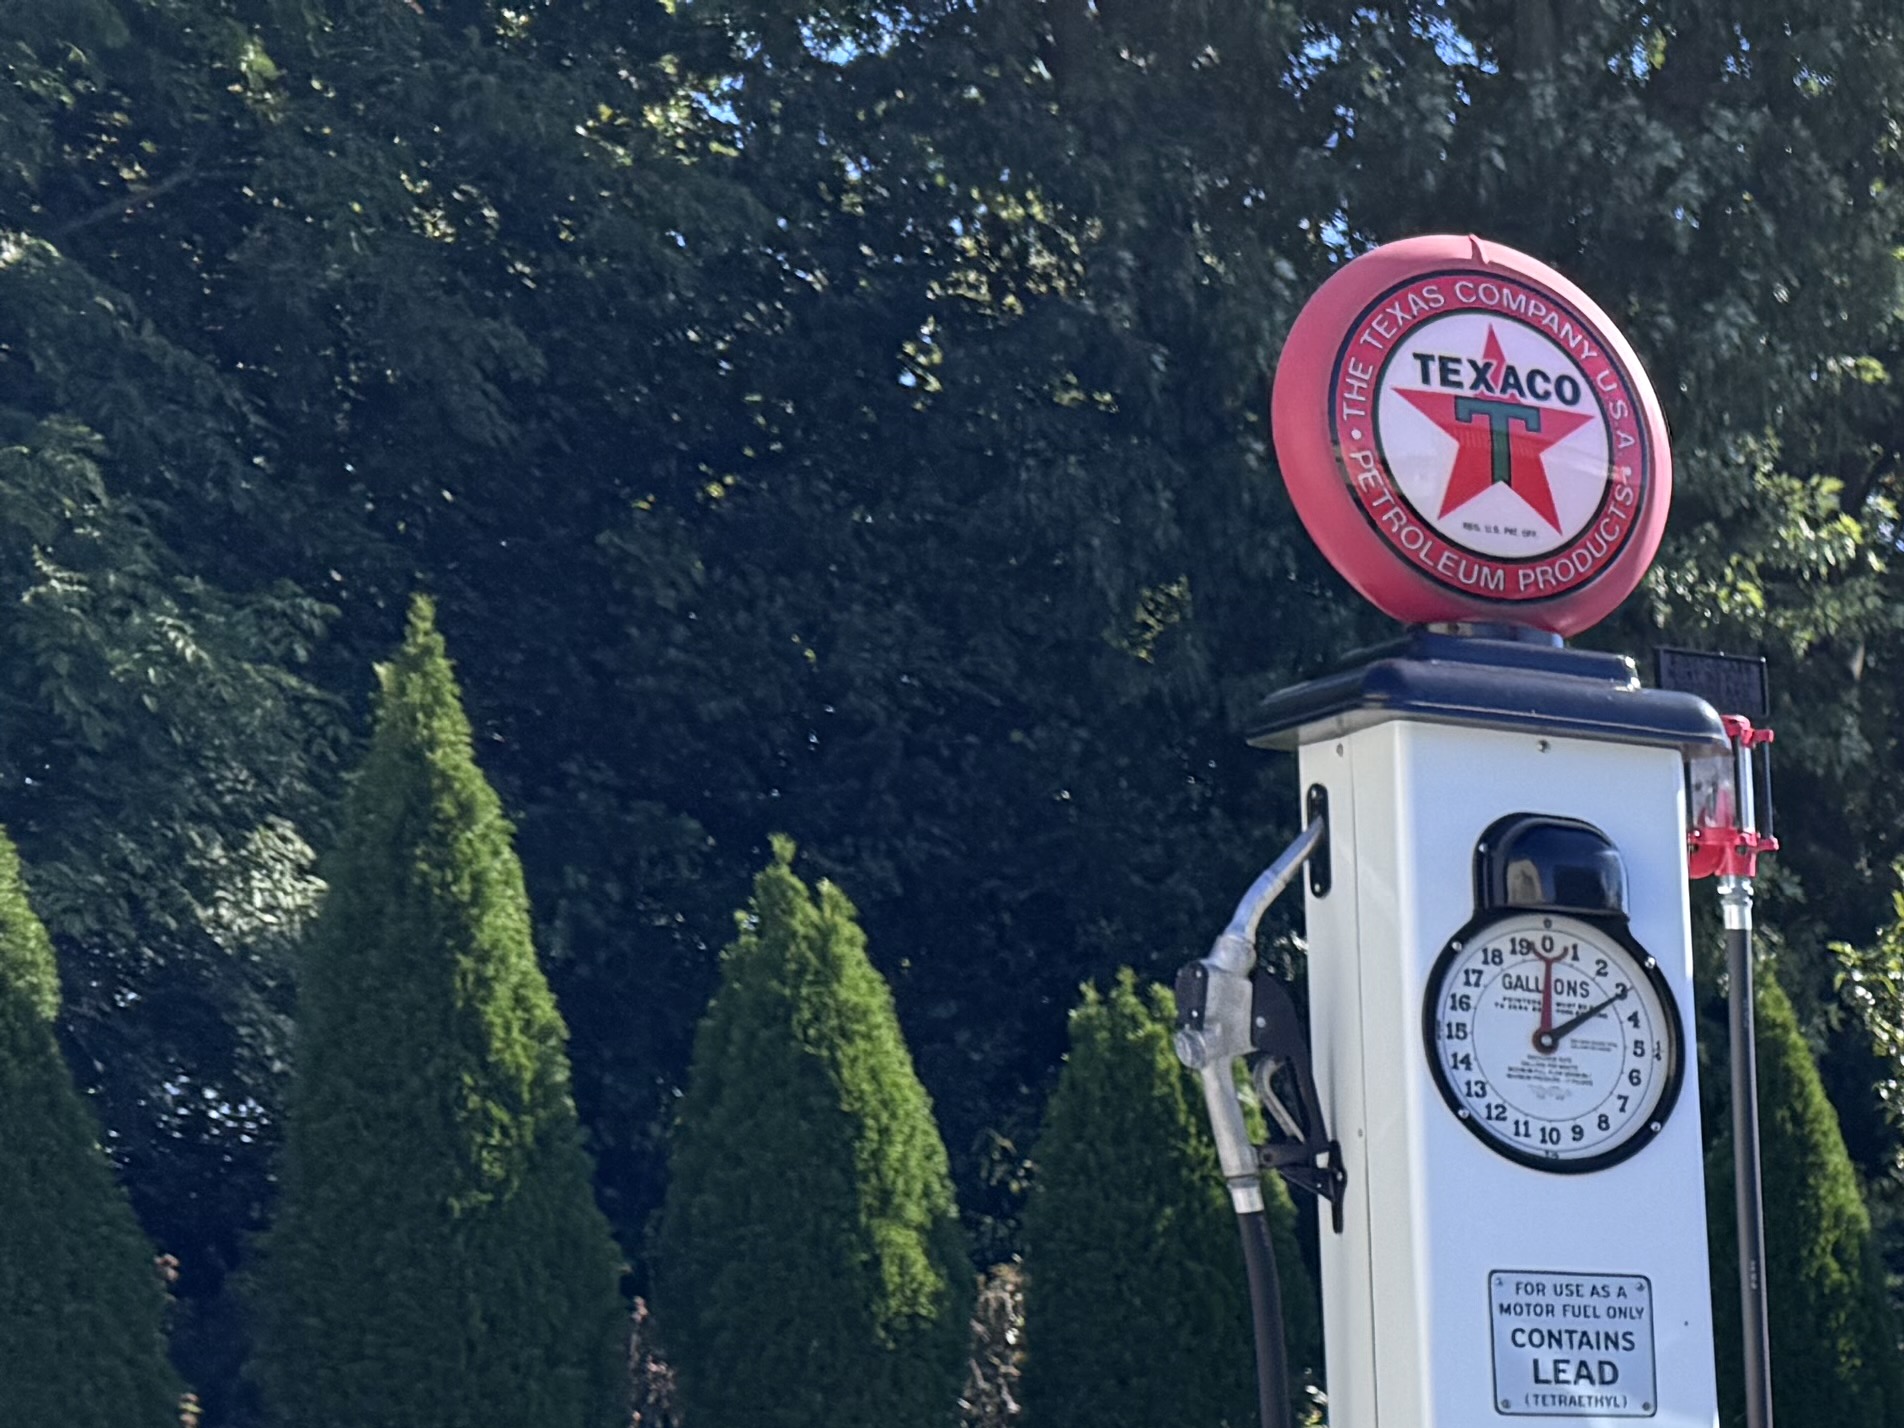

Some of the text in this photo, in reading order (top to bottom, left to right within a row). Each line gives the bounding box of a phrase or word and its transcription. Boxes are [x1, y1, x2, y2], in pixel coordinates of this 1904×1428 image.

[1343, 358, 1373, 421] THE
[1360, 284, 1445, 351] TEXAS
[1454, 281, 1598, 360] COMPANY
[1412, 352, 1581, 406] TEXACO
[1350, 450, 1633, 592] PETROLEUM PRODUCTS
[1541, 935, 1554, 953] 0
[1571, 943, 1580, 961] 1
[1482, 947, 1503, 965] 18
[1595, 959, 1609, 977] 2
[1462, 968, 1484, 988] 17
[1502, 973, 1590, 999] GALLONS
[1450, 992, 1471, 1012] 16
[1627, 1011, 1640, 1029] 4
[1446, 1021, 1468, 1040] 15
[1633, 1040, 1646, 1058] 5
[1451, 1051, 1473, 1071] 14
[1628, 1069, 1642, 1087] 6
[1464, 1079, 1487, 1099] 13
[1485, 1103, 1508, 1123] 12
[1617, 1094, 1630, 1113] 7
[1512, 1120, 1532, 1138] 11
[1597, 1114, 1611, 1132] 8
[1540, 1126, 1561, 1145] 10
[1571, 1124, 1585, 1142] 9
[1515, 1281, 1628, 1299] FOR USE AS A
[1499, 1303, 1645, 1320] MOTOR FUEL ONLY
[1511, 1328, 1636, 1352] CONTAINS
[1532, 1358, 1620, 1386] LEAD
